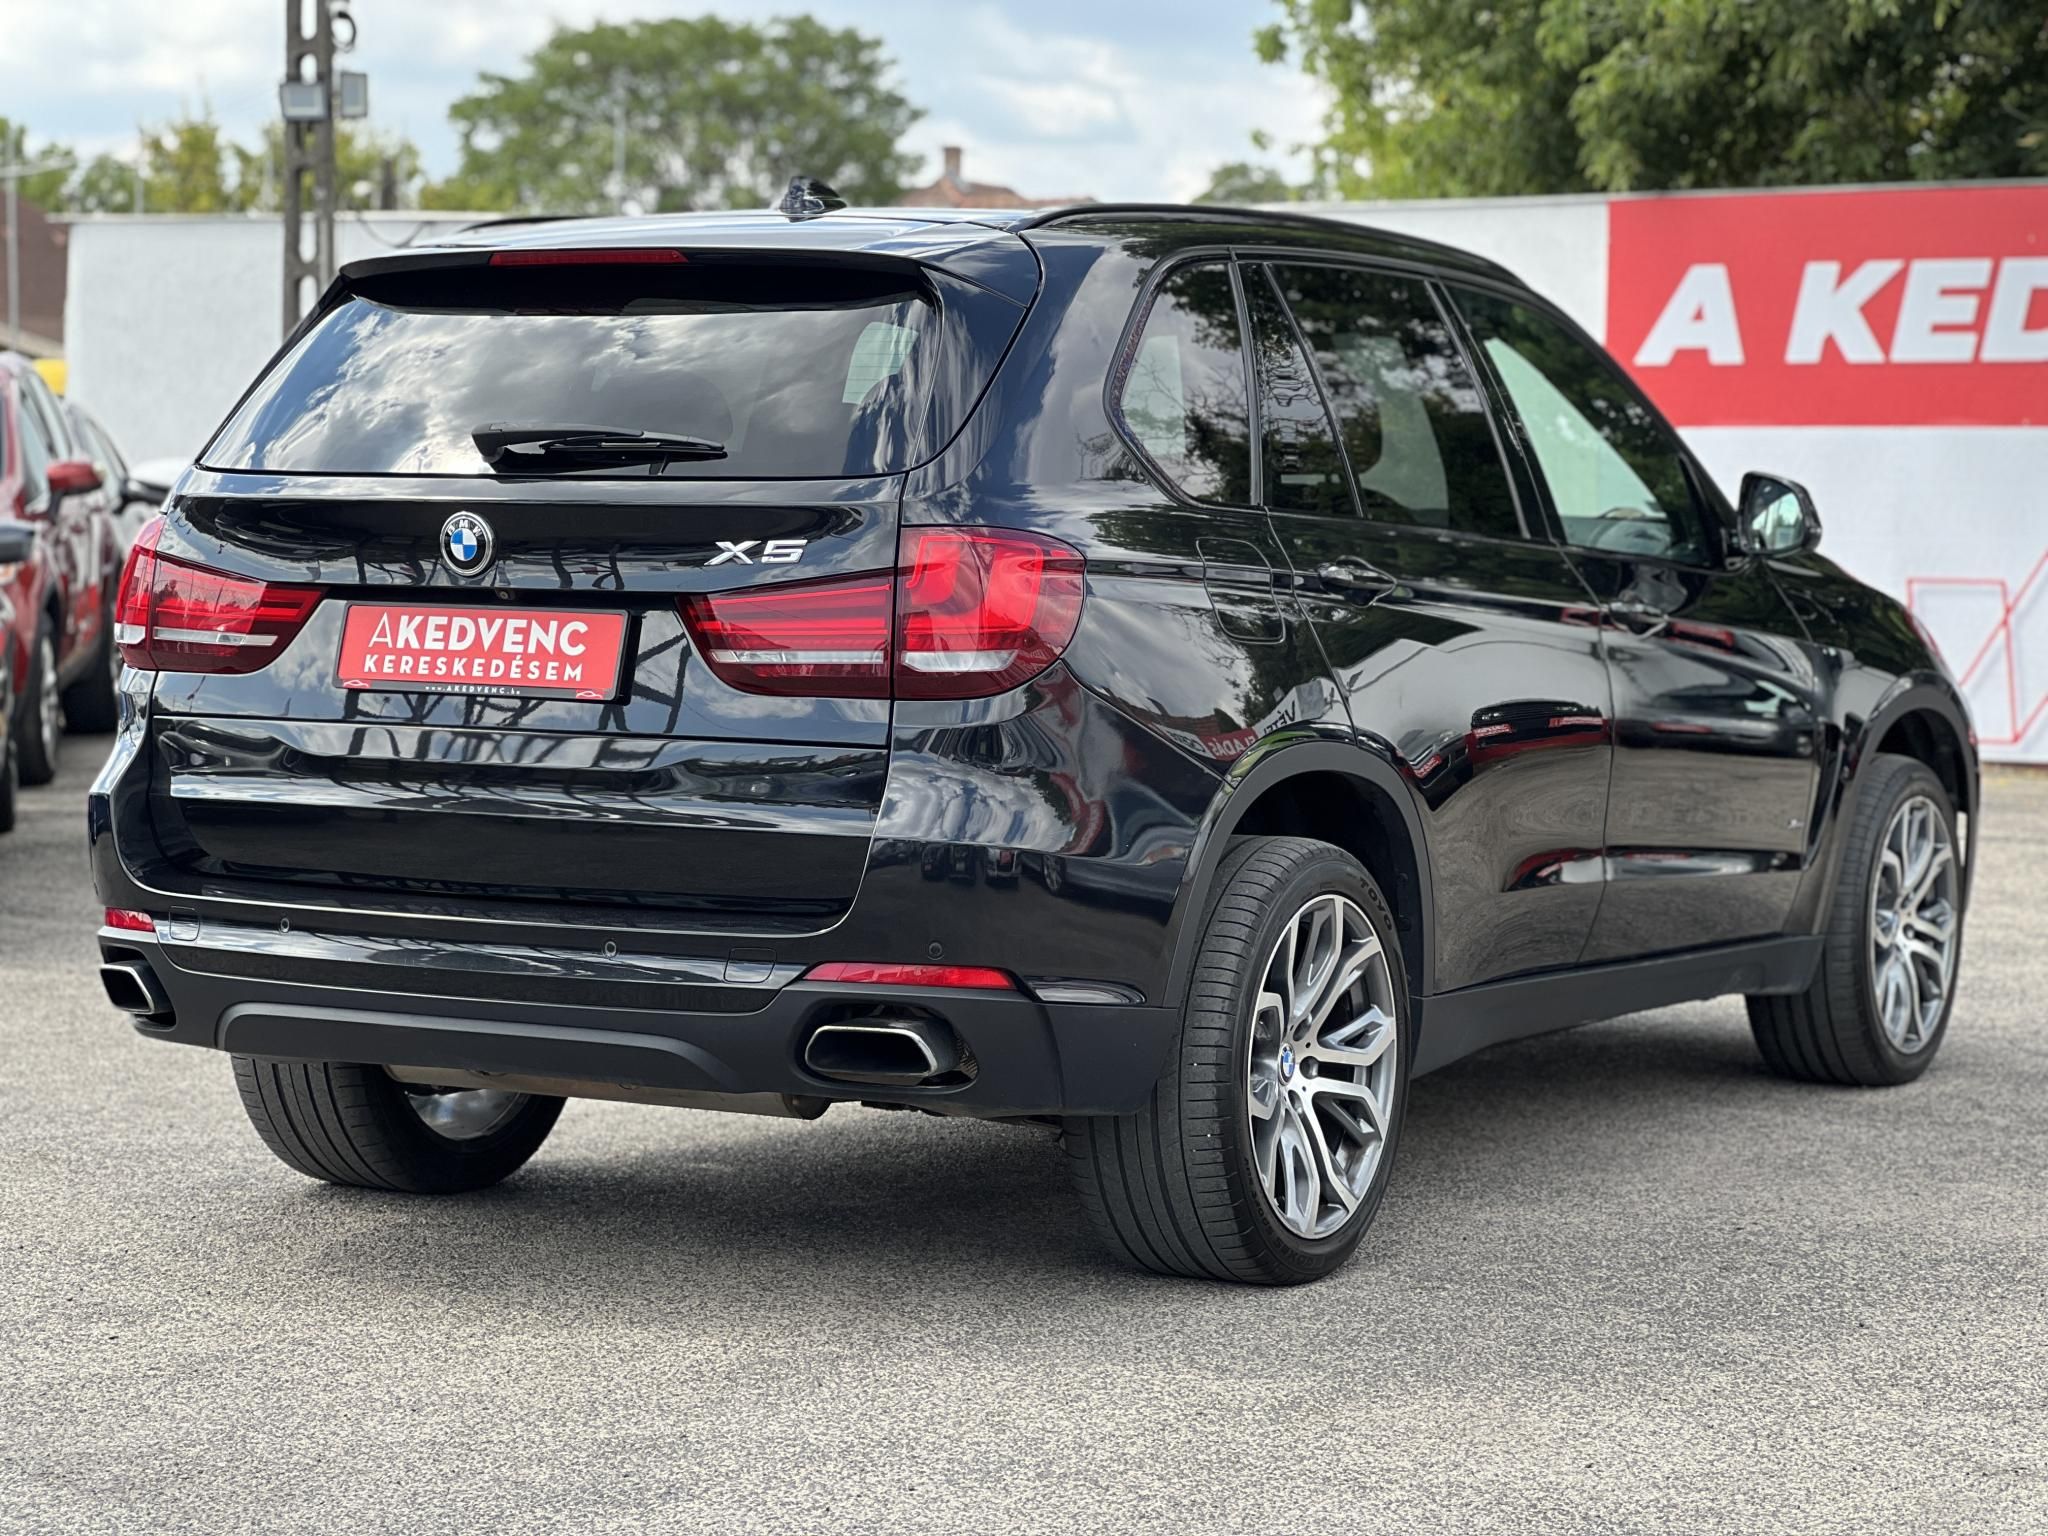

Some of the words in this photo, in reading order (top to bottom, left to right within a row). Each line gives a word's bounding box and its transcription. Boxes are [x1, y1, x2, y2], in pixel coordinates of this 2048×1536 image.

[1633, 263, 1745, 367] A
[447, 519, 482, 537] BMW
[704, 540, 808, 566] X5
[363, 654, 583, 682] KERESKEDÉSEM
[1360, 876, 1392, 931] TOYO
